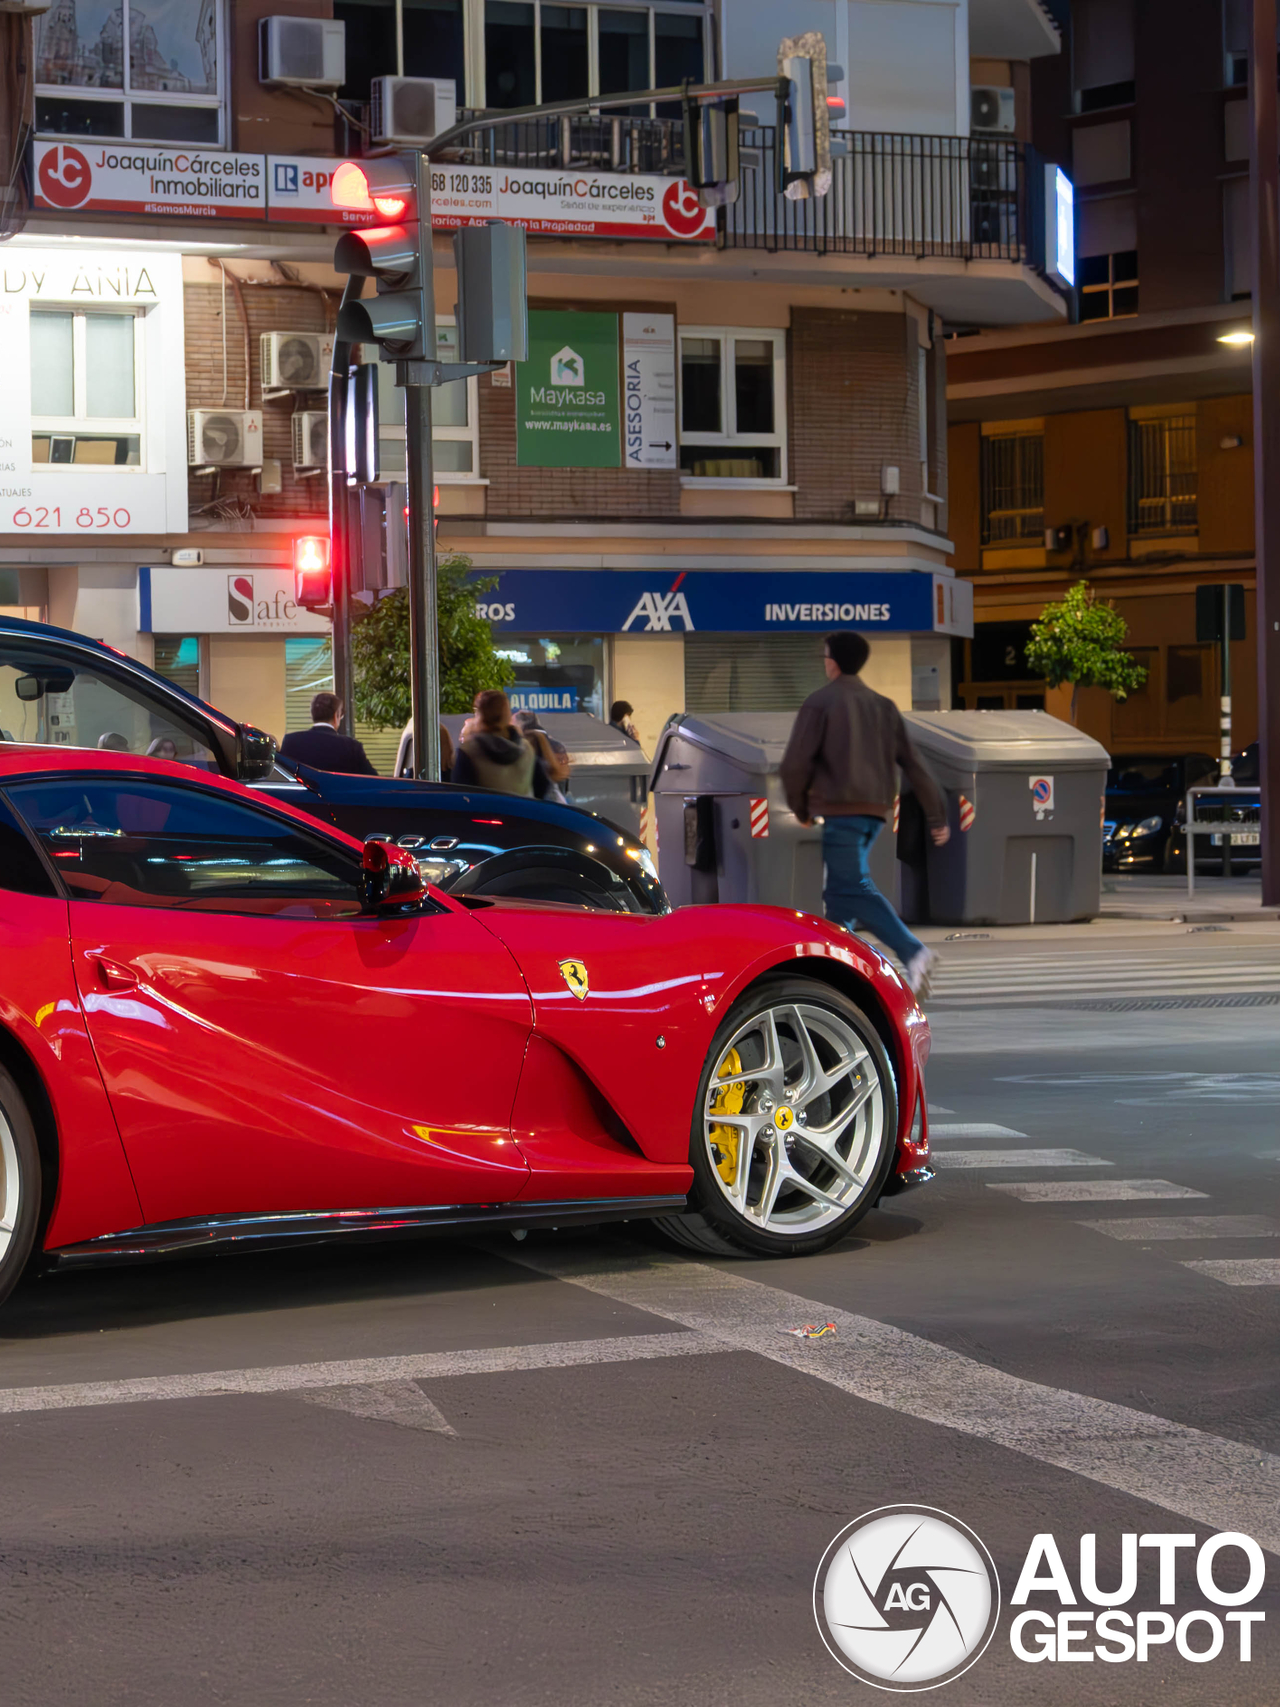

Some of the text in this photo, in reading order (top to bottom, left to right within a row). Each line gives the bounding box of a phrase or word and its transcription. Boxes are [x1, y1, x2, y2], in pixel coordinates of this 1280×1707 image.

[150, 175, 259, 199] Inmobiliaria
[450, 174, 469, 193] 120
[472, 175, 492, 194] 335
[144, 203, 216, 216] #SomosMurcia
[529, 221, 540, 230] la
[541, 221, 595, 233] Propiedad
[71, 265, 157, 297] ANIA
[530, 386, 606, 408] Maykasa
[626, 359, 644, 463] ASESORIA
[524, 419, 613, 433] www.maykasa.es
[12, 506, 62, 528] 621
[75, 506, 132, 529] 850
[228, 574, 297, 623] Safe
[620, 591, 696, 632] AXA
[764, 603, 891, 622] INVERSIONES
[1004, 645, 1017, 666] 2
[509, 692, 573, 710] ALQUILA
